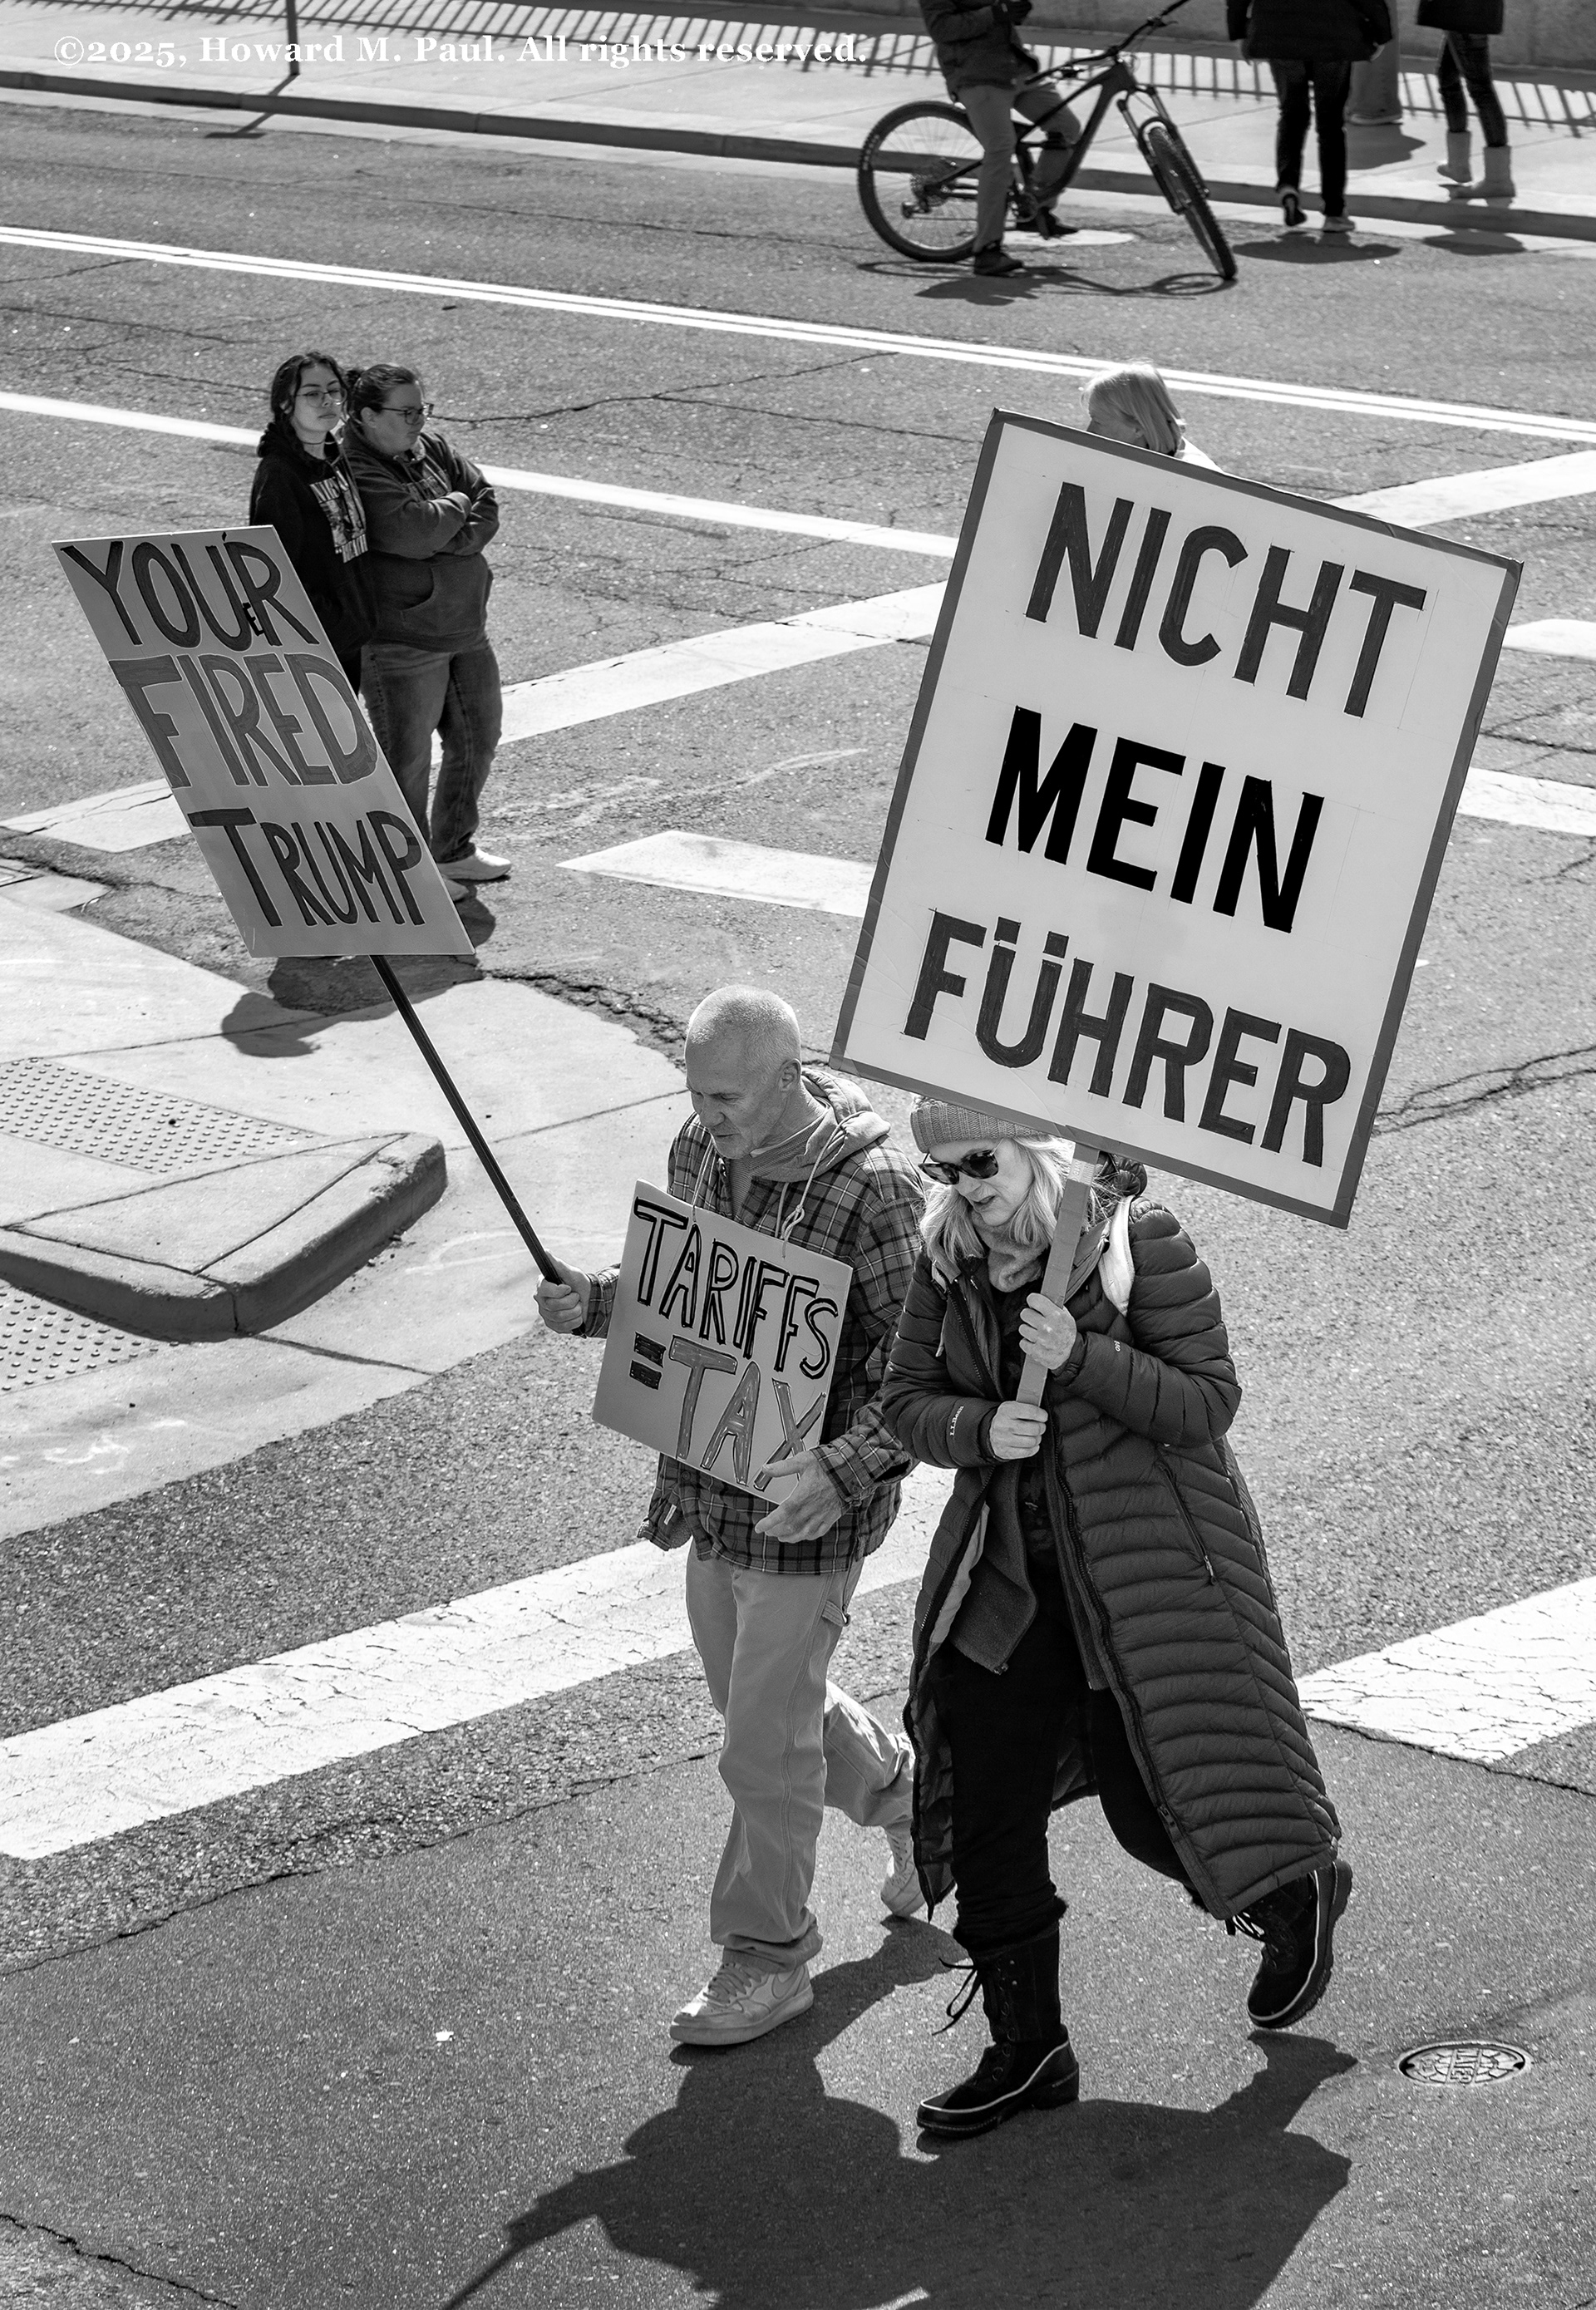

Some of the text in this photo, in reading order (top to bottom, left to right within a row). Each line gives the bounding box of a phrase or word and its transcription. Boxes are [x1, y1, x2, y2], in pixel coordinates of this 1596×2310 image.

[1023, 481, 1427, 718] NICHT
[109, 653, 379, 788] FIRED
[188, 807, 426, 928] TRUMP
[985, 705, 1324, 933] MEIN
[903, 908, 1352, 1167] FÜHRER
[633, 1197, 839, 1380] TARIFFS
[668, 1334, 826, 1491] TAX
